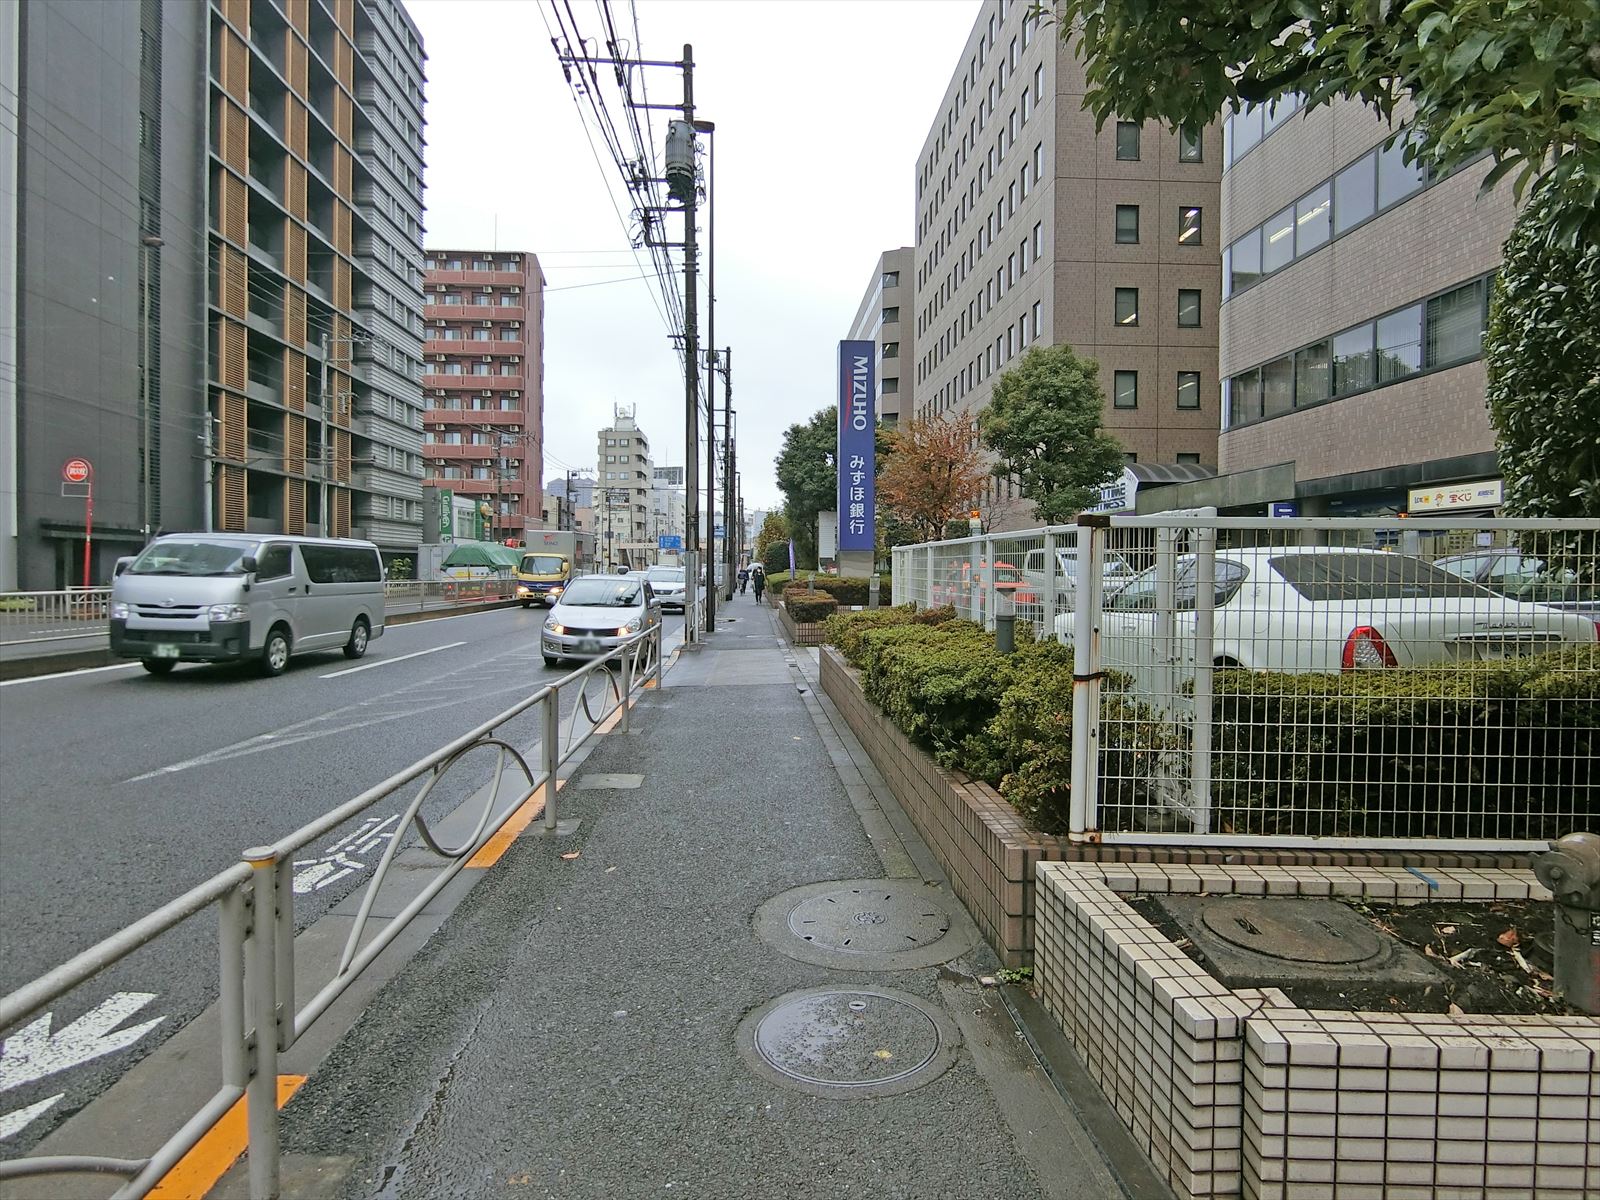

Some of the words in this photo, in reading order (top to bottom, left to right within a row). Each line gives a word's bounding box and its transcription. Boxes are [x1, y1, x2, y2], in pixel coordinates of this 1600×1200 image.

[853, 355, 868, 431] MIZUHO
[849, 455, 866, 535] みずほ銀行
[1449, 492, 1472, 504] 宝くじ
